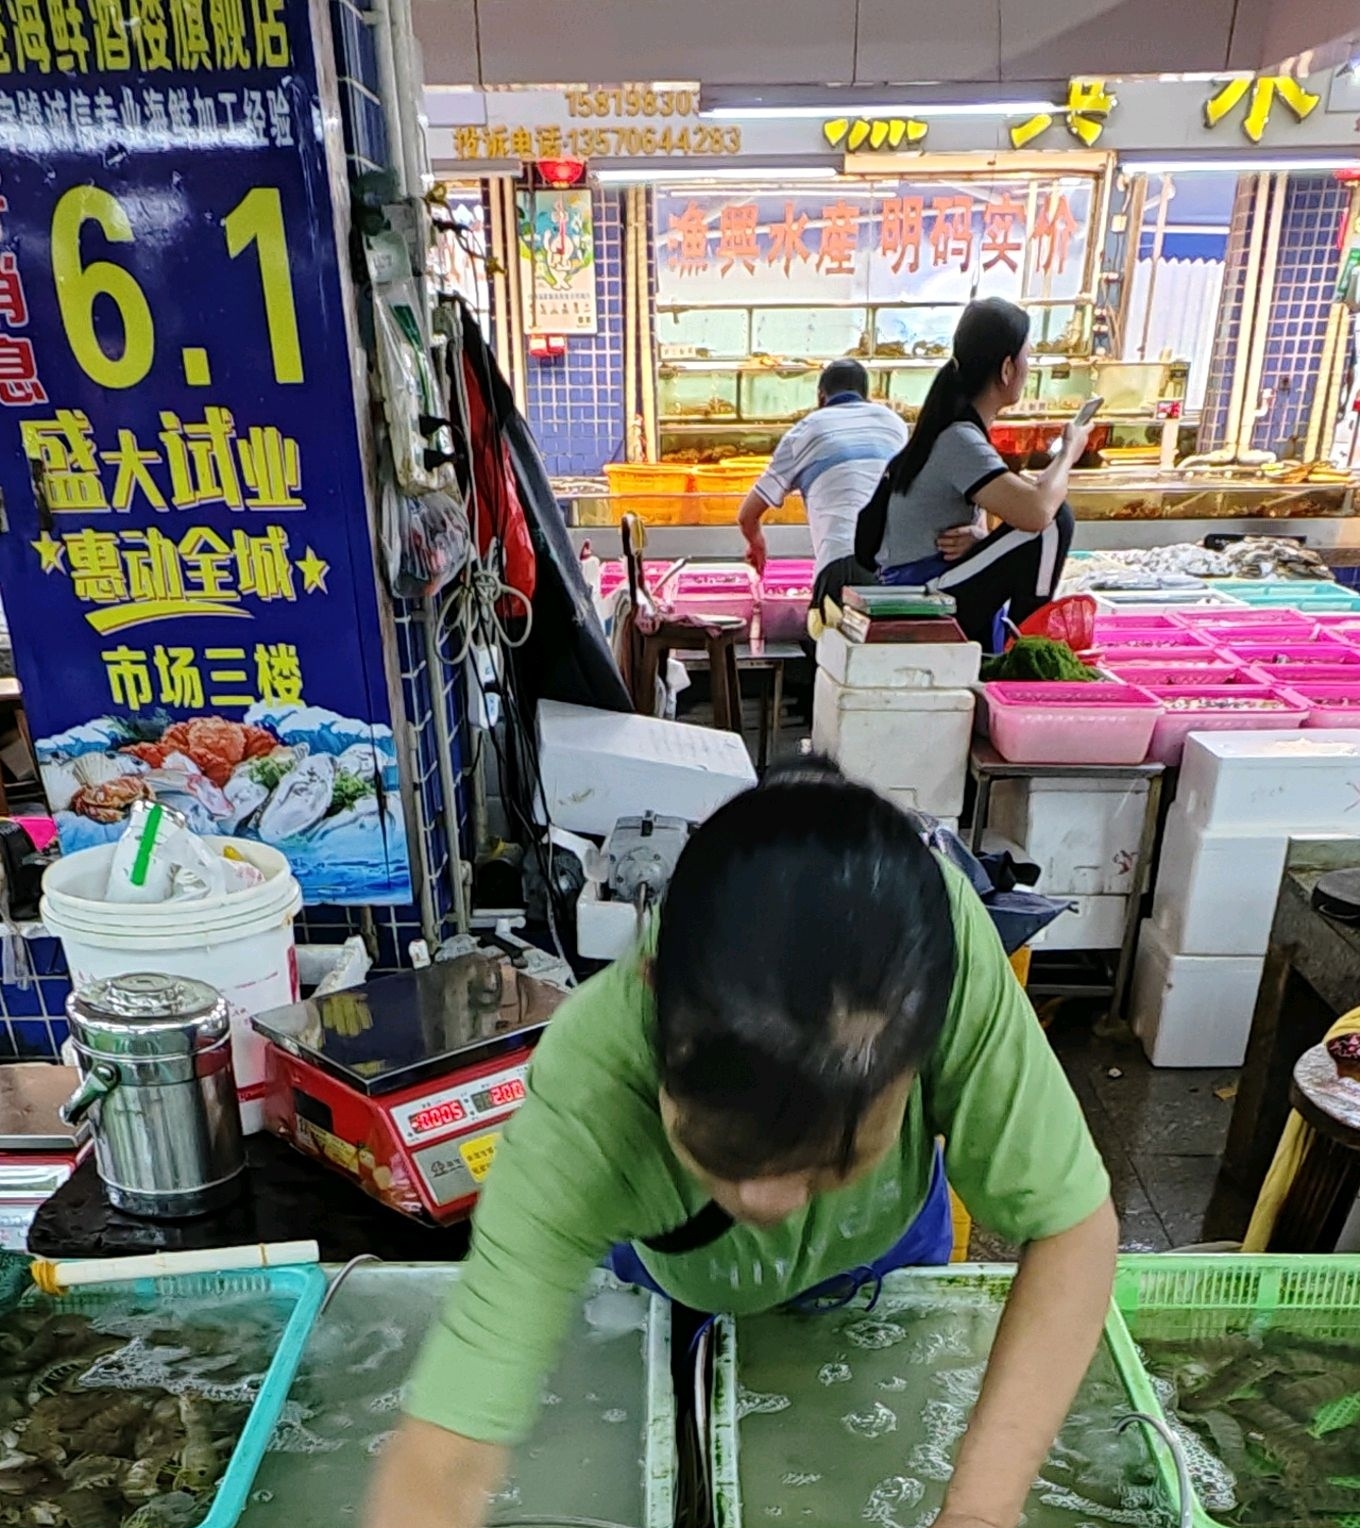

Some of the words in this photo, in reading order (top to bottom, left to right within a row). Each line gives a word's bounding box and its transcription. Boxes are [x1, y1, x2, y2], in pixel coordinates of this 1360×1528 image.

[50, 184, 305, 390] 6.1
[19, 405, 308, 514] 盛大试业
[62, 524, 297, 602] 惠动全城
[100, 642, 306, 711] 市场三楼
